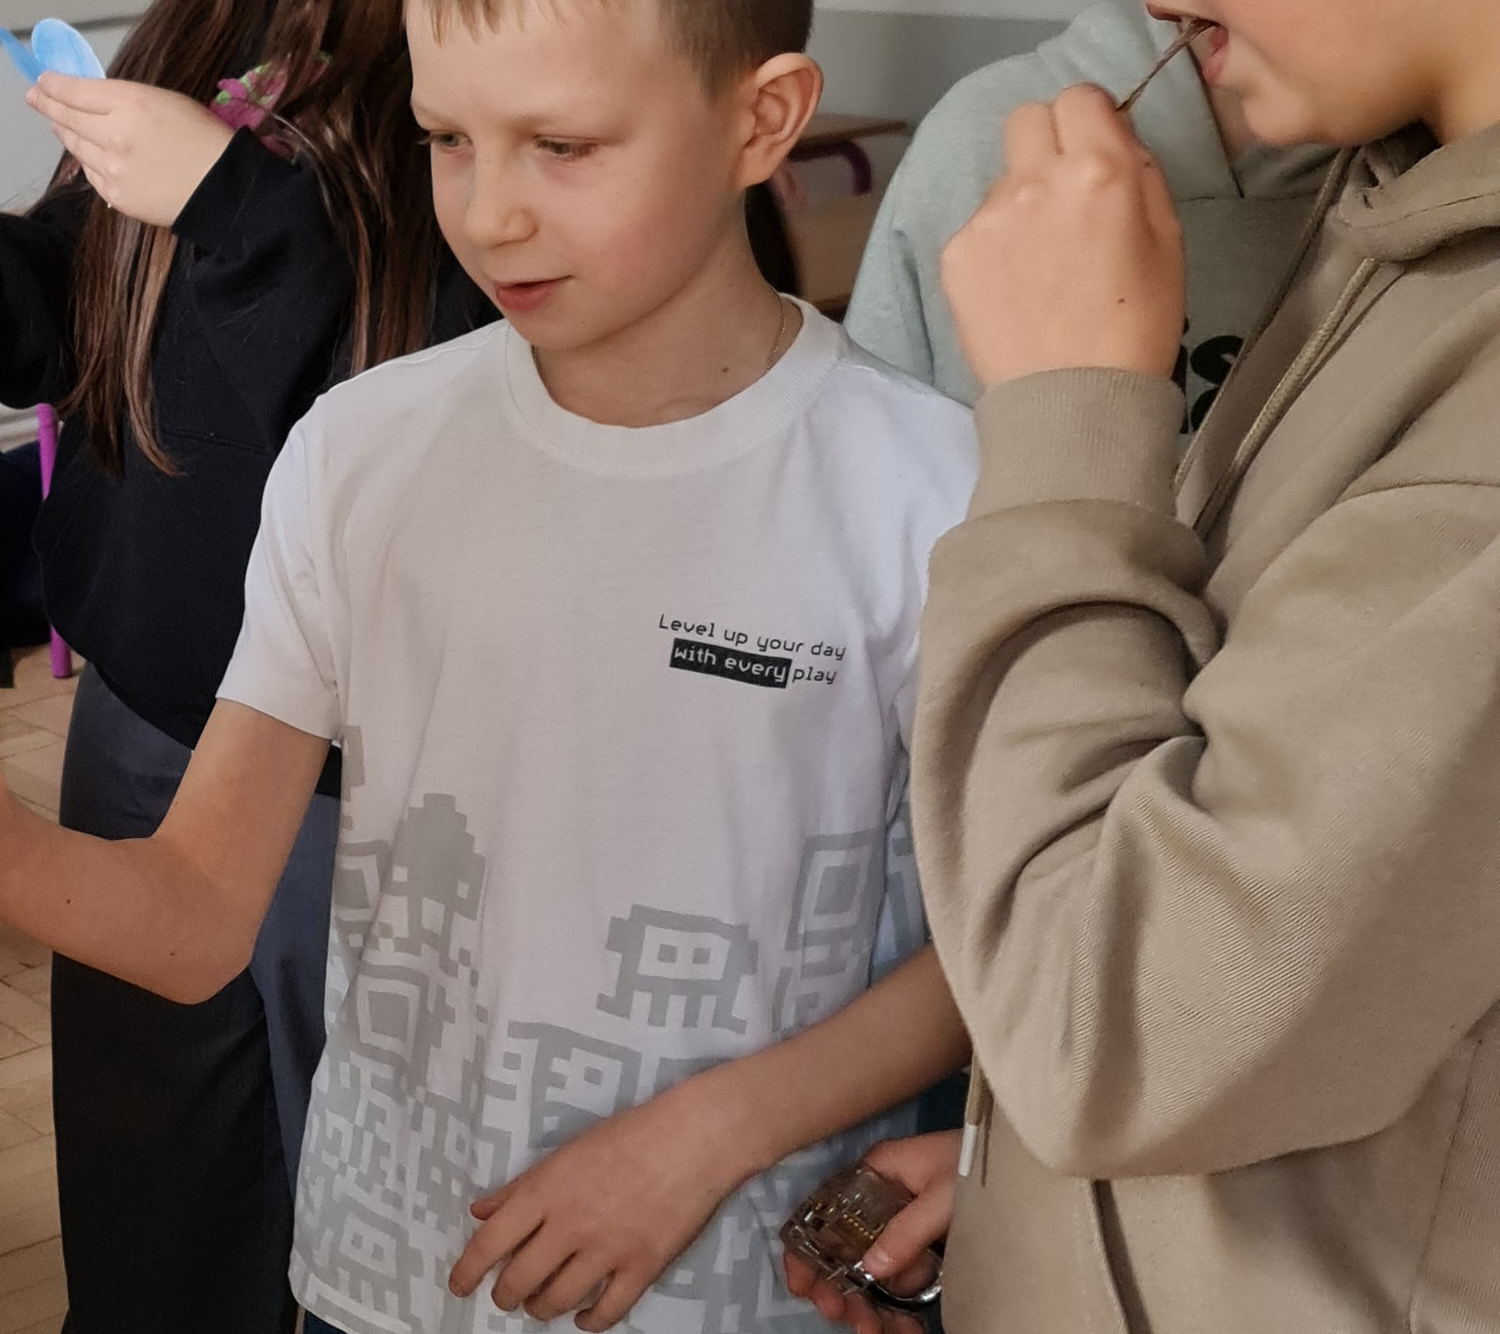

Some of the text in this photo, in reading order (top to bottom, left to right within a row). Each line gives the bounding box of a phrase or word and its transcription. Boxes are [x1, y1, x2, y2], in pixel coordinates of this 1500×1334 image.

[658, 613, 846, 661] Level up your day
[673, 644, 838, 685] with every play
